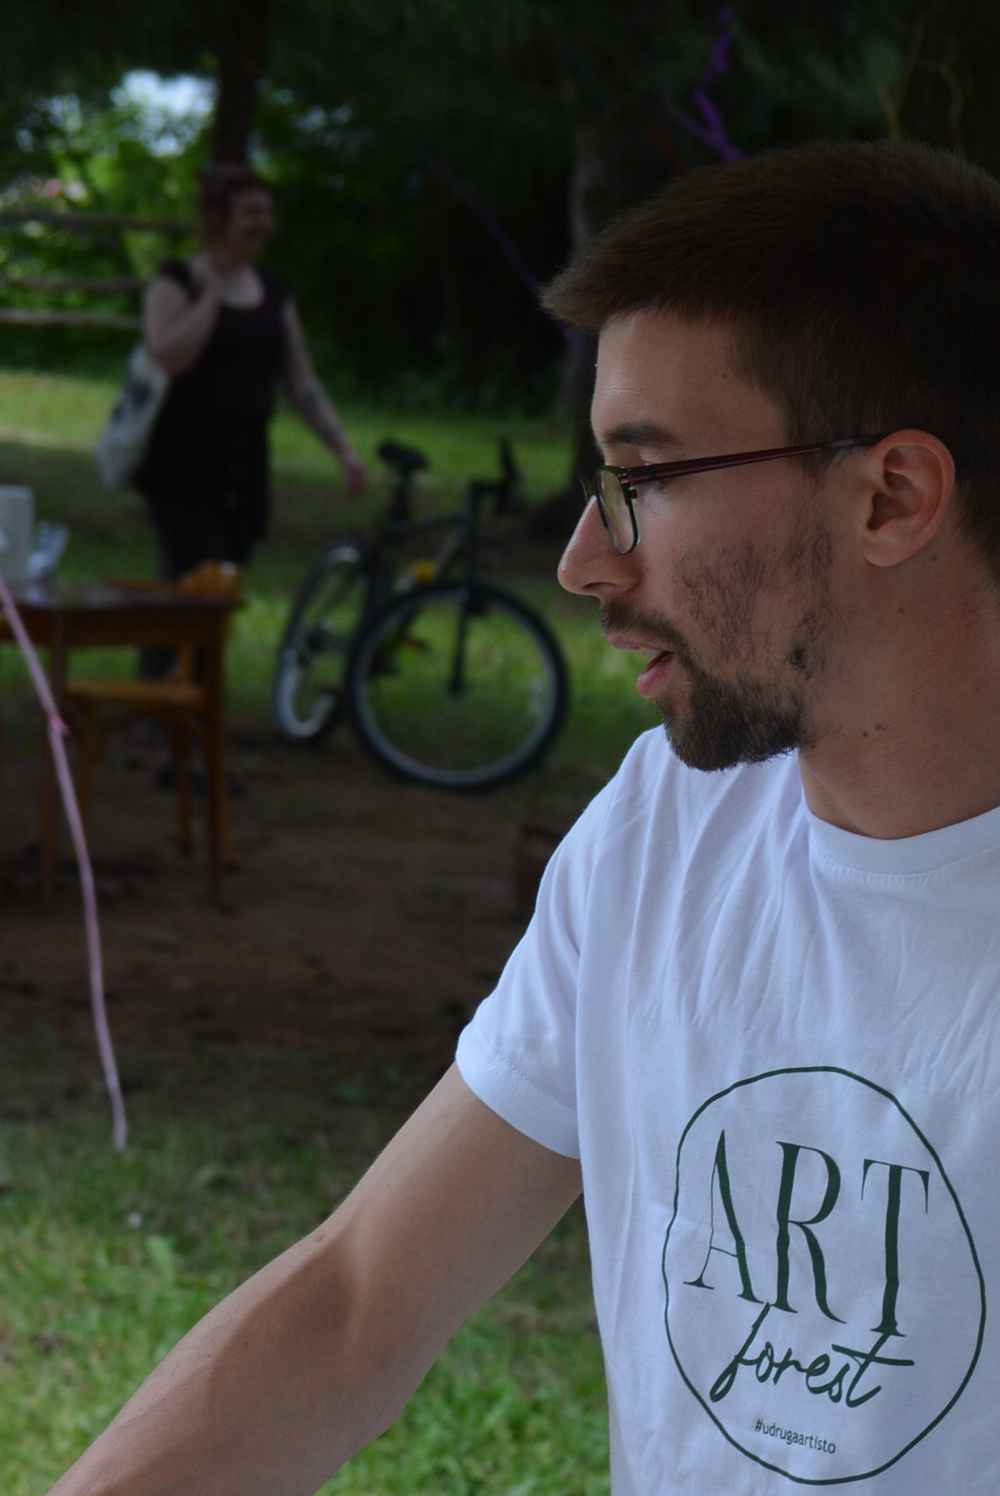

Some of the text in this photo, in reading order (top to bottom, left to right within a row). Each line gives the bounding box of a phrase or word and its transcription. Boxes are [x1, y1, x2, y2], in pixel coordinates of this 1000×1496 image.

[683, 1129, 930, 1337] ART
[709, 1302, 915, 1407] forest
[754, 1417, 837, 1455] #udrugaartisto
